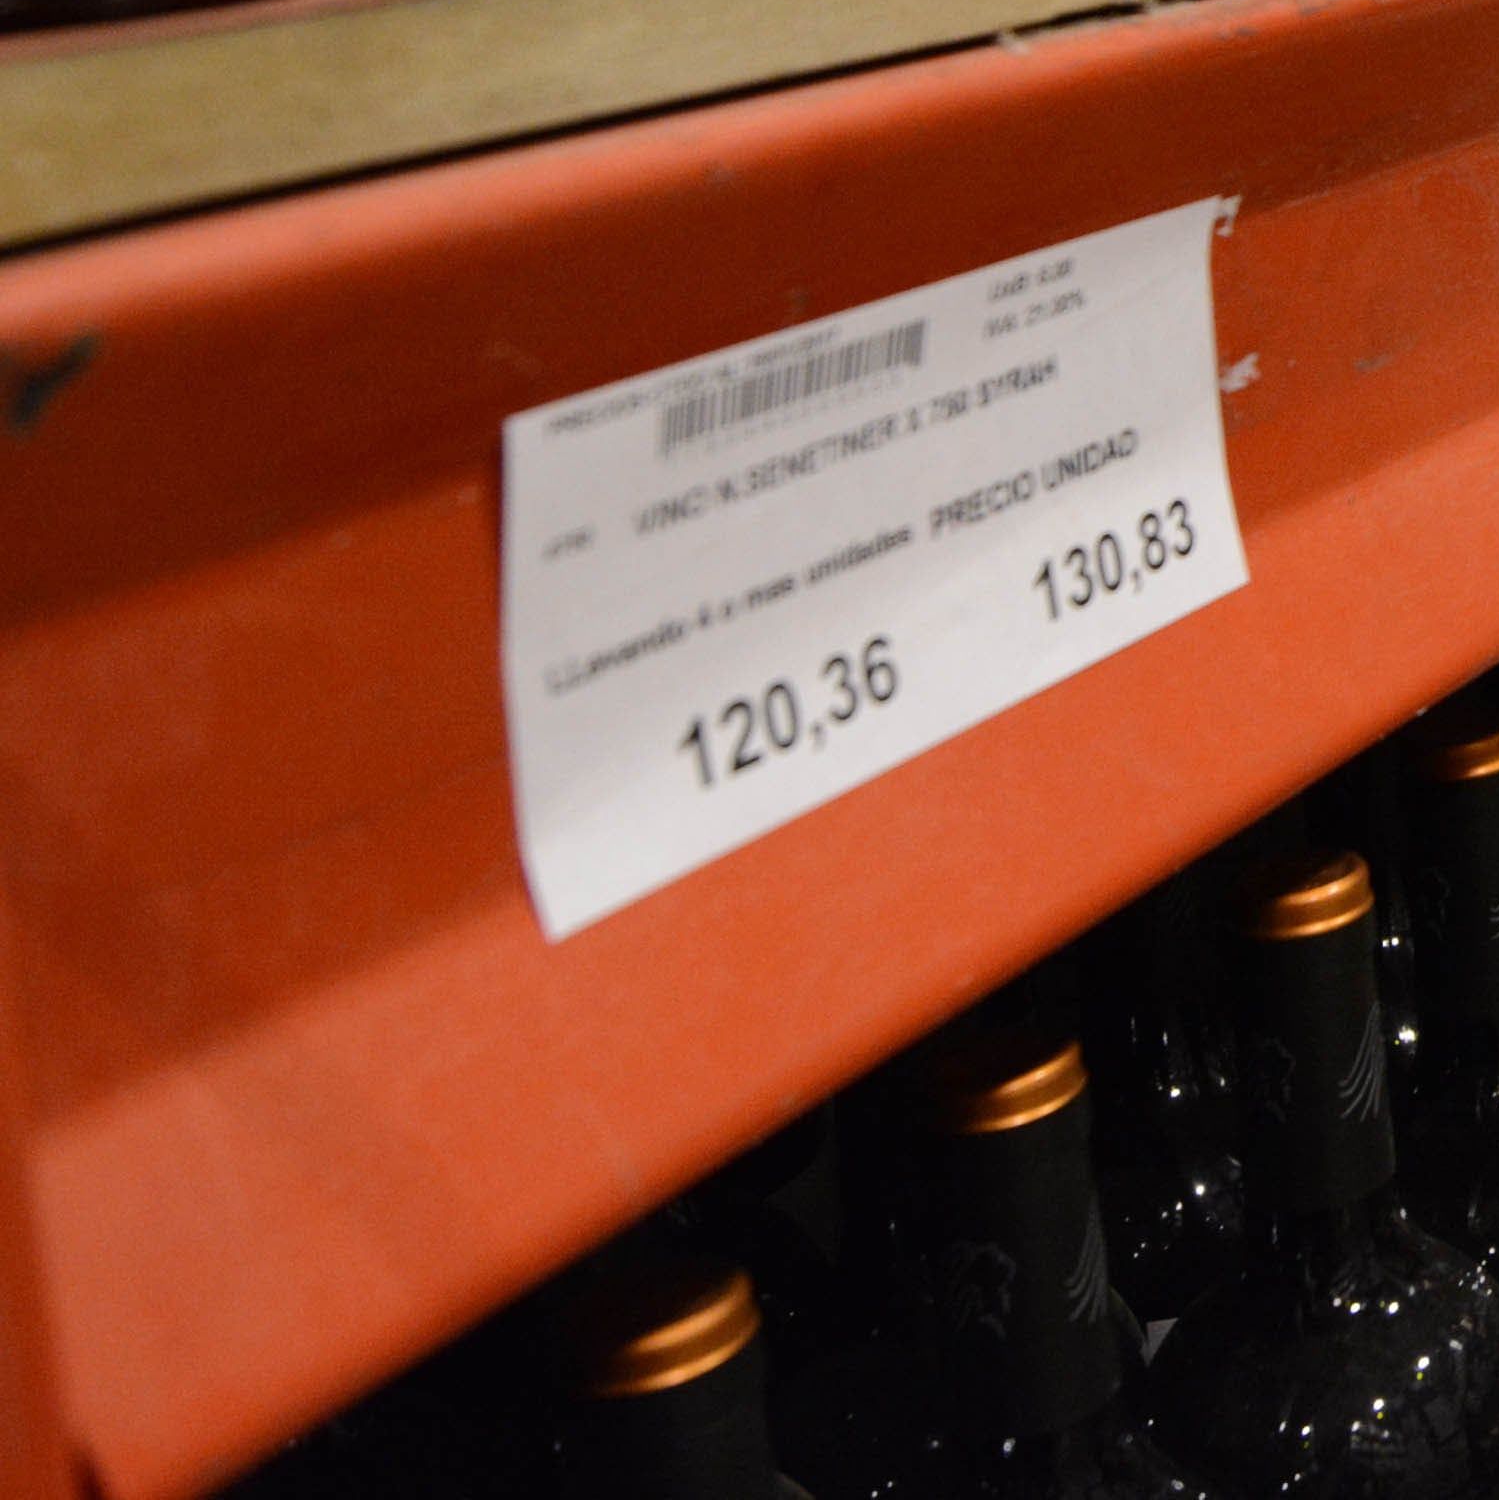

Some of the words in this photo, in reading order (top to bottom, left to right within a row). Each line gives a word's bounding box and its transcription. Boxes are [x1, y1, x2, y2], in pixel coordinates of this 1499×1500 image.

[930, 467, 1033, 540] PRECIO
[1041, 428, 1139, 492] UNIDAD
[677, 635, 900, 790] 120,36
[1031, 497, 1196, 621] 130,83
